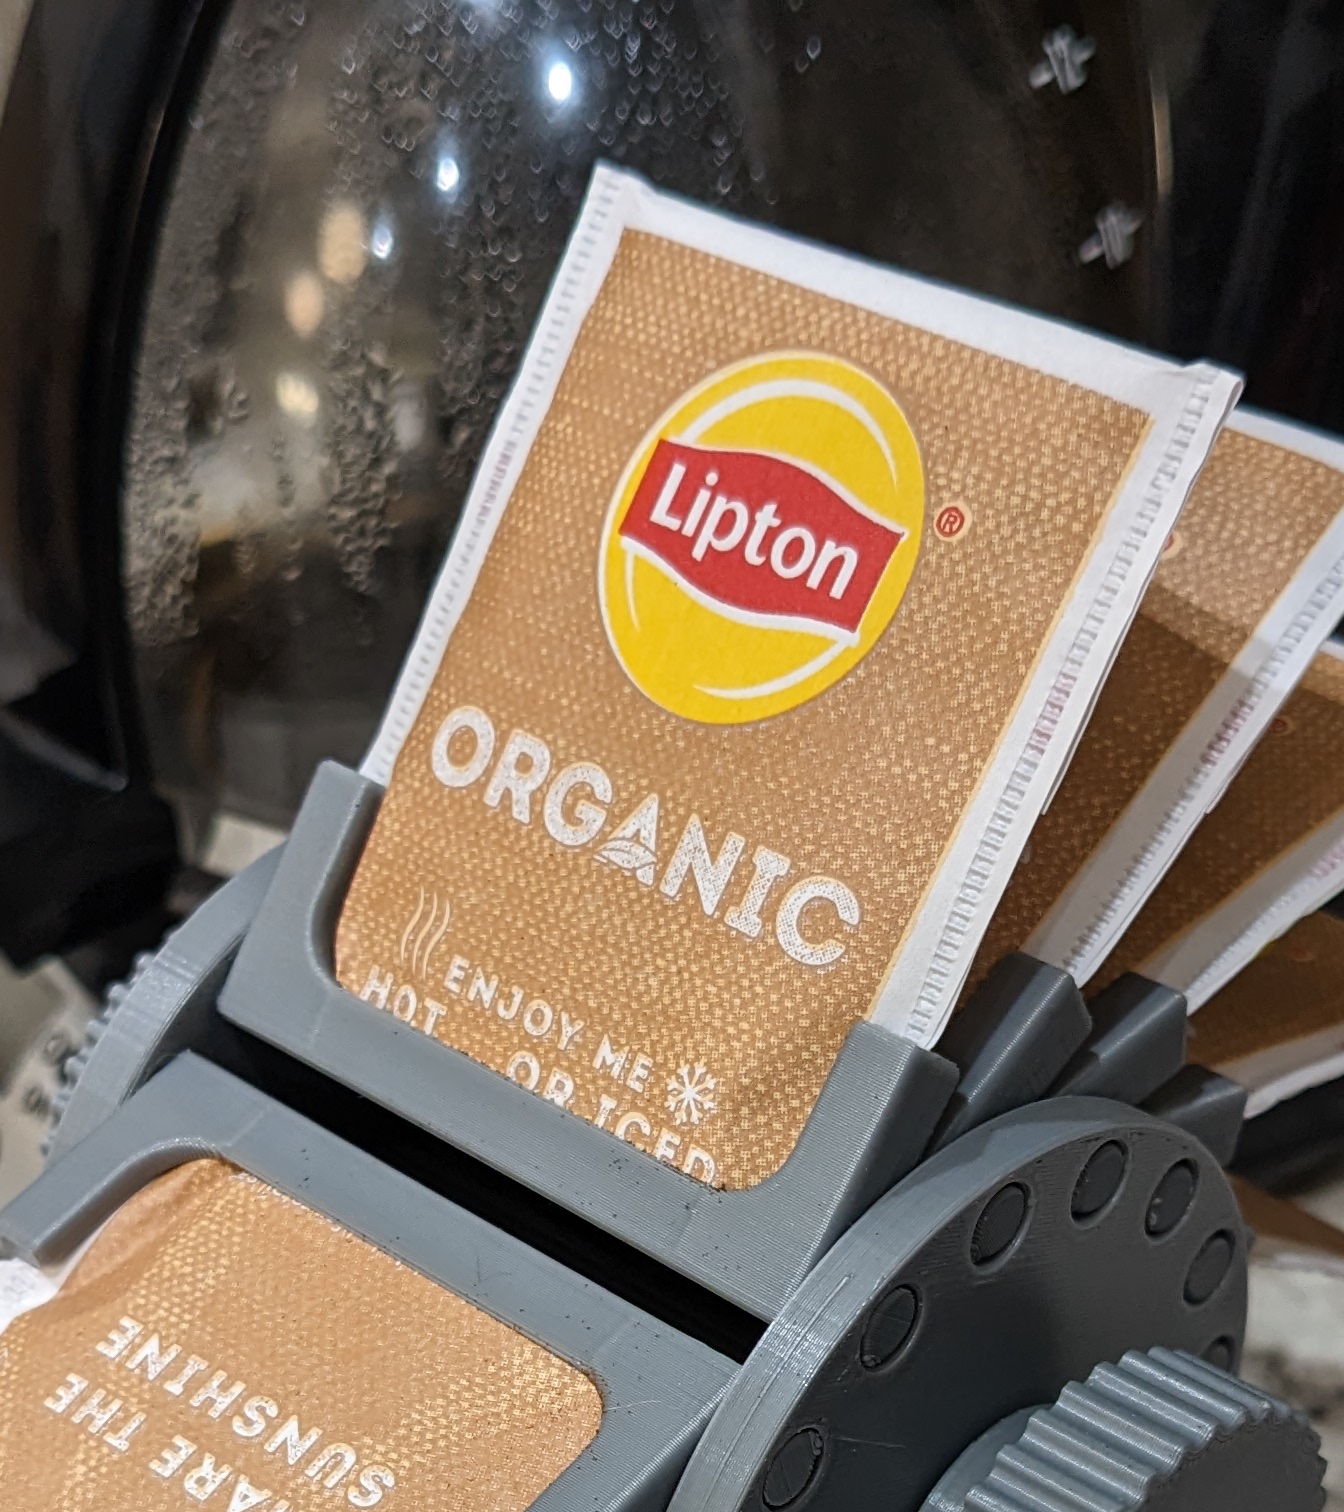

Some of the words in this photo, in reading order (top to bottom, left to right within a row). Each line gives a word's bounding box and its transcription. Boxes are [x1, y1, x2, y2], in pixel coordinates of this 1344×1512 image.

[649, 461, 859, 600] Lipton
[430, 704, 860, 966] ORGANIC
[358, 964, 447, 1038] HOT
[505, 1050, 576, 1110] OR
[443, 953, 585, 1051] ENJOY
[592, 1034, 654, 1094] ME
[44, 1372, 147, 1451] THE
[94, 1315, 395, 1508] SUNSHINE
